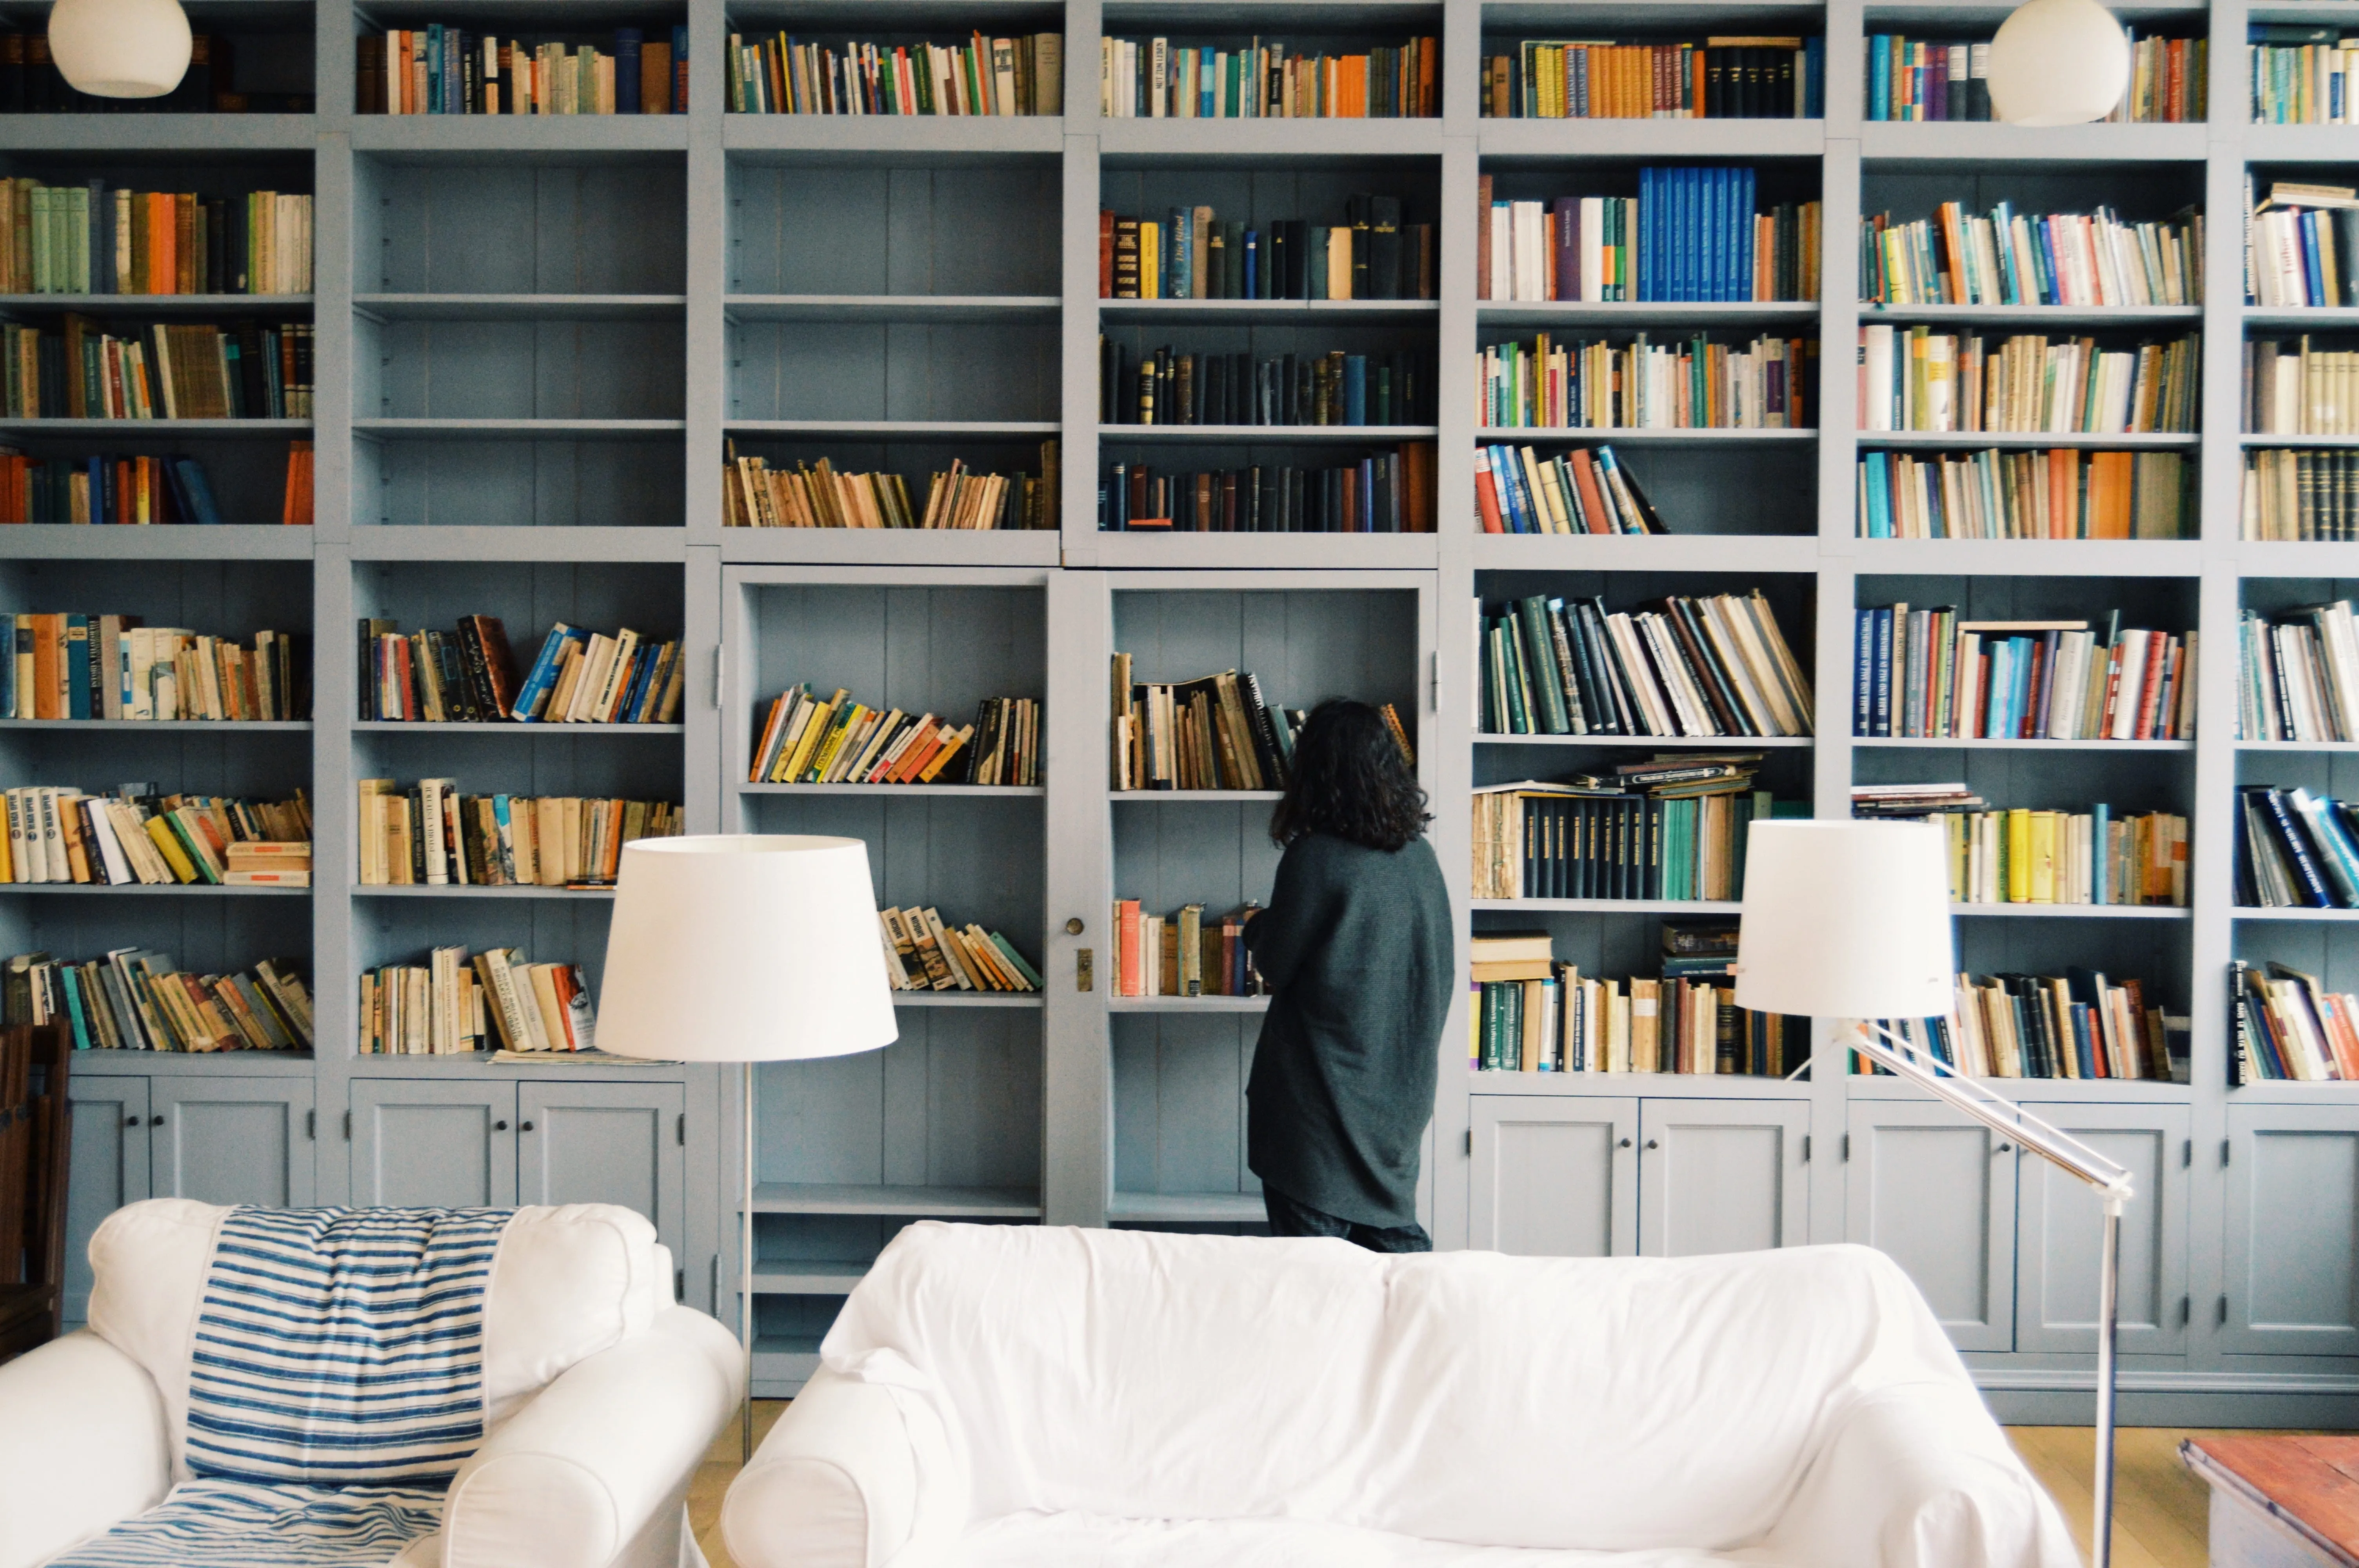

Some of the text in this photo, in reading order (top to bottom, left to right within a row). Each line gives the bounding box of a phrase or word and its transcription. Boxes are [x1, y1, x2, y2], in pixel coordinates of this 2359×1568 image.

[1174, 215, 1184, 261] Die Bibel
[1860, 617, 1870, 658] SIEBENBÜRGEN
[1878, 618, 1889, 659] SIEBENBÜRGEN
[1896, 608, 1905, 663] PETER JACOBI
[1859, 668, 1868, 680] SALZ
[1878, 669, 1887, 681] SALZ
[1859, 682, 1868, 694] UND
[1878, 683, 1887, 695] UND
[1859, 695, 1868, 714] SILBER
[1877, 697, 1886, 715] SILBER
[8, 794, 20, 828] BLAGA OPERE
[25, 796, 35, 829] BLAGA OPERE
[42, 794, 54, 828] BLAGA OPERE
[2237, 1049, 2245, 1059] DU
